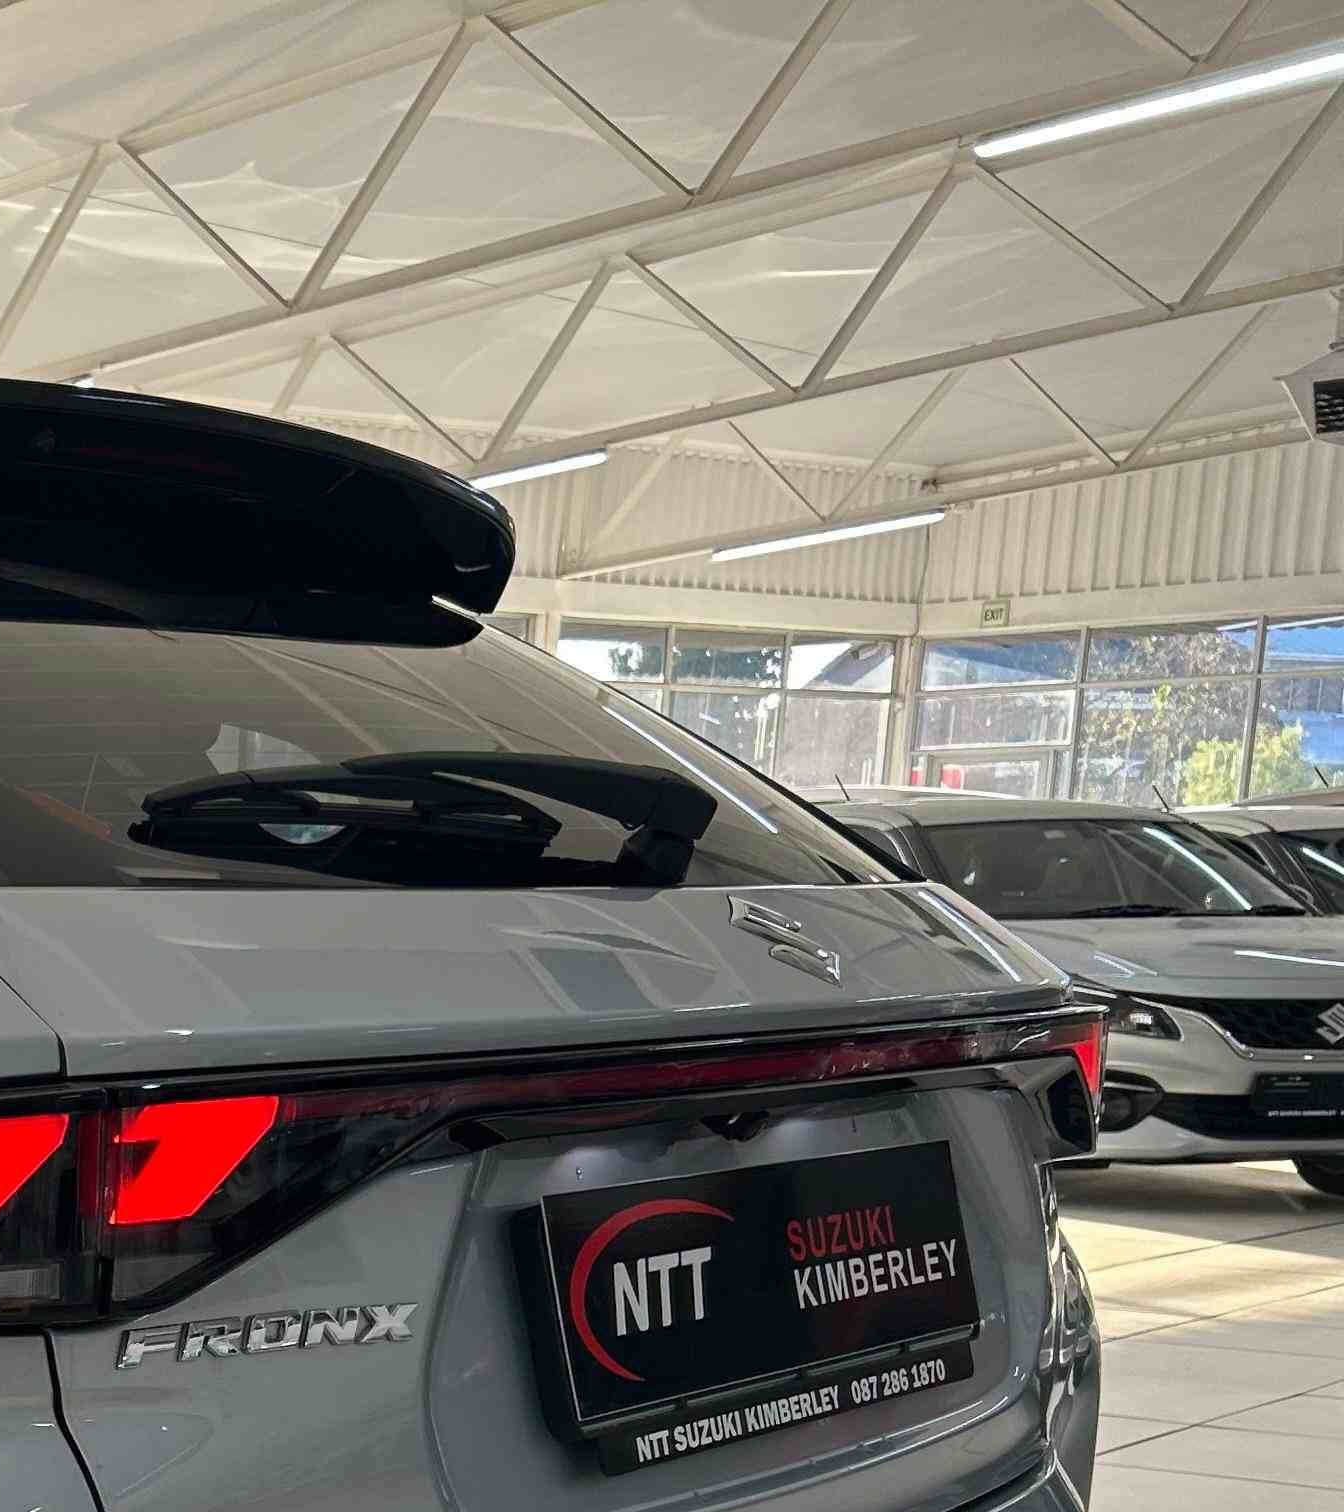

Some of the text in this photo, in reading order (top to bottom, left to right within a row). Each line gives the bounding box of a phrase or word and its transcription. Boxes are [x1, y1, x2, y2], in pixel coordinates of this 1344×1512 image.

[984, 608, 1004, 621] EXIT
[787, 1205, 896, 1262] SUZUKI
[613, 1246, 712, 1336] NTT
[793, 1238, 957, 1310] KIMBERLEY
[114, 1302, 419, 1370] FRONX
[635, 1358, 946, 1462] NTT SUZUKI KIMBERLEY 087 286 1870
